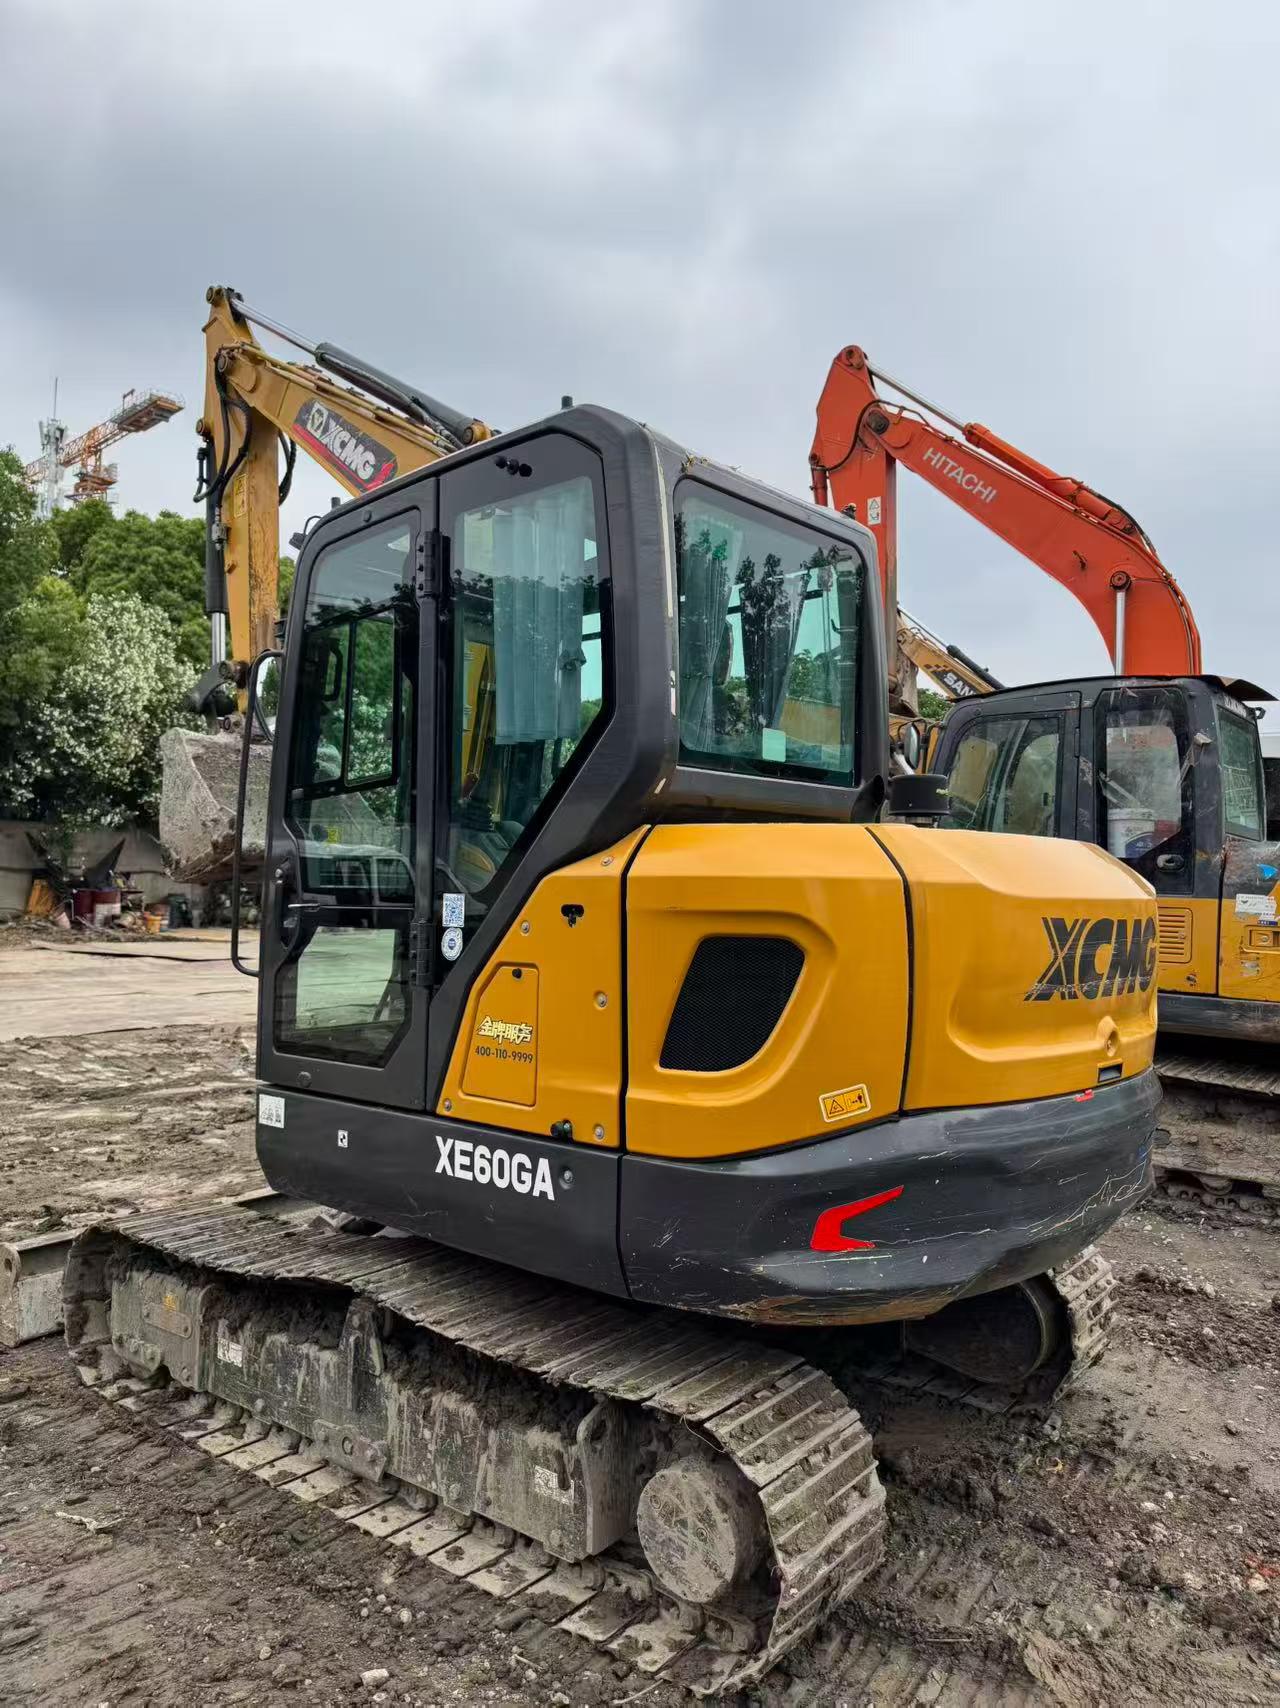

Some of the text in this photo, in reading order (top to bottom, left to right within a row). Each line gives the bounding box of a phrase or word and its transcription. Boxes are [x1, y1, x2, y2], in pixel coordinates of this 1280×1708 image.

[320, 417, 376, 480] XCMG
[923, 447, 997, 503] HITACHI
[943, 672, 977, 697] SAN
[1023, 916, 1157, 1001] XCMG
[475, 1045, 533, 1064] 400-110-9999
[477, 1015, 533, 1044] 金牌服务
[434, 1135, 555, 1201] XE60GA
